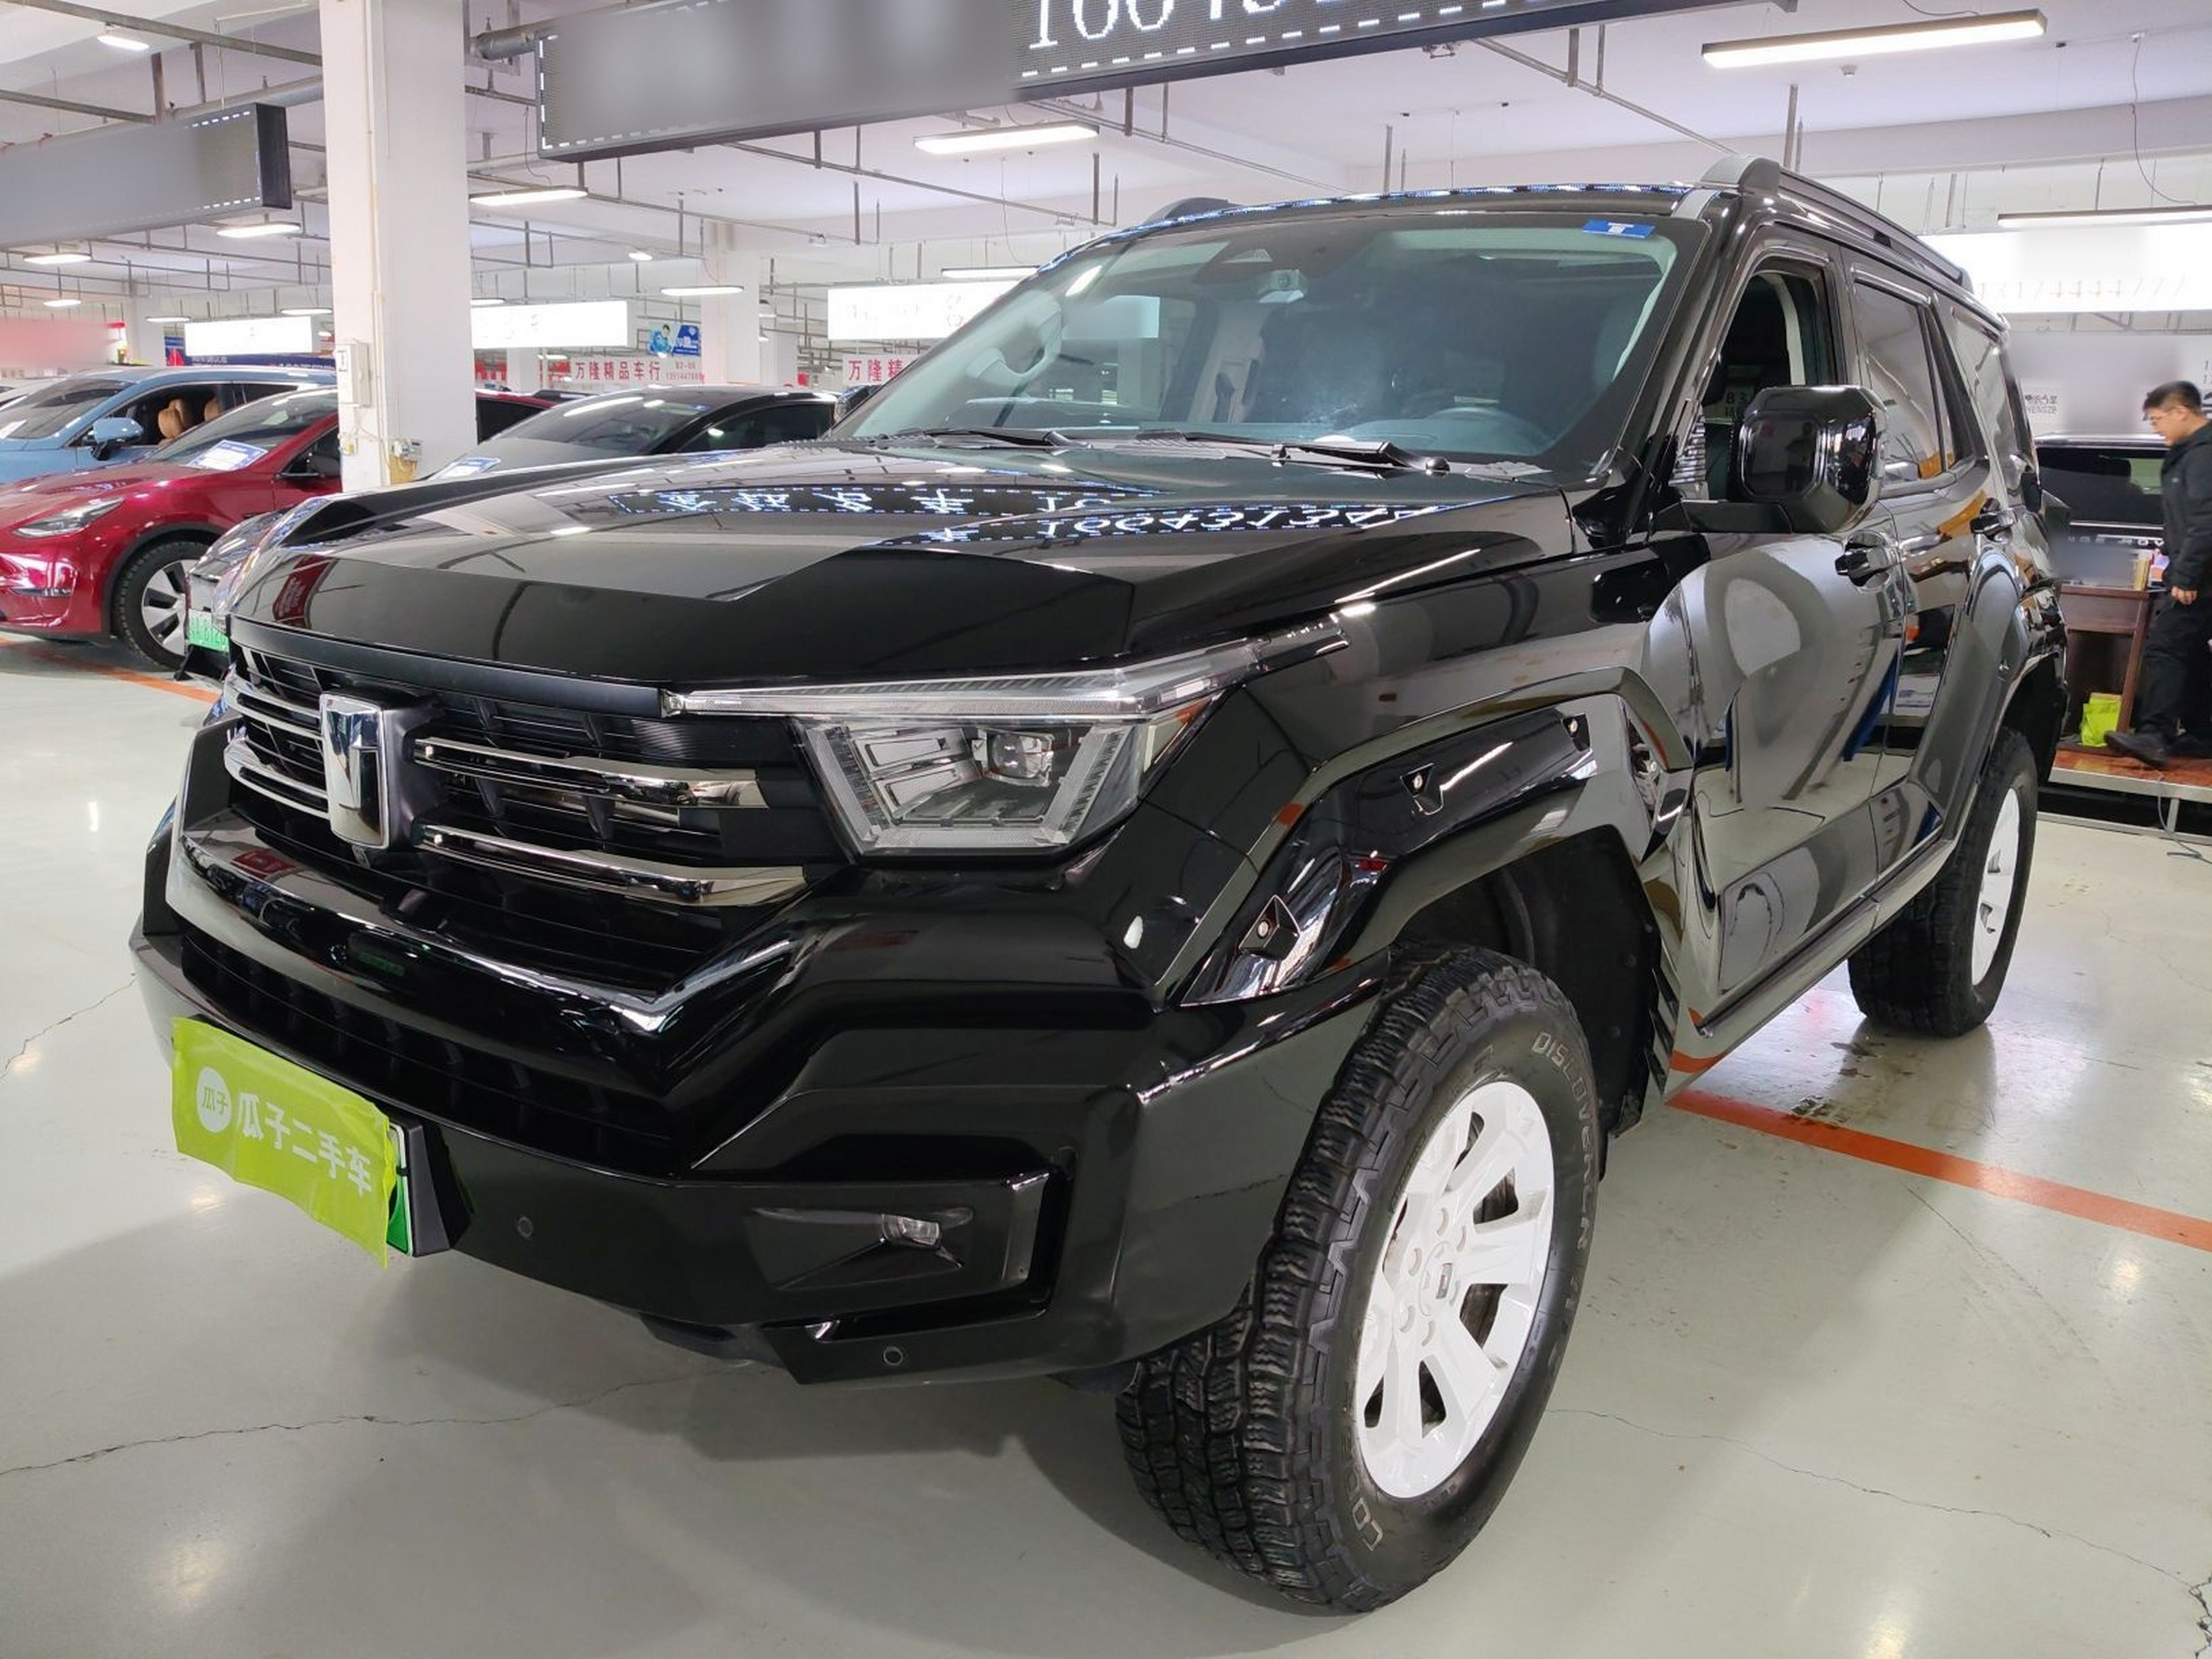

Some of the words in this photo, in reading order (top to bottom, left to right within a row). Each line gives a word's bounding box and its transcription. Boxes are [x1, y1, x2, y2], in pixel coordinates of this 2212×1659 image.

[575, 361, 661, 380] 万隆精品车行
[203, 1086, 228, 1115] 瓜子
[237, 1092, 372, 1197] 瓜子二手车
